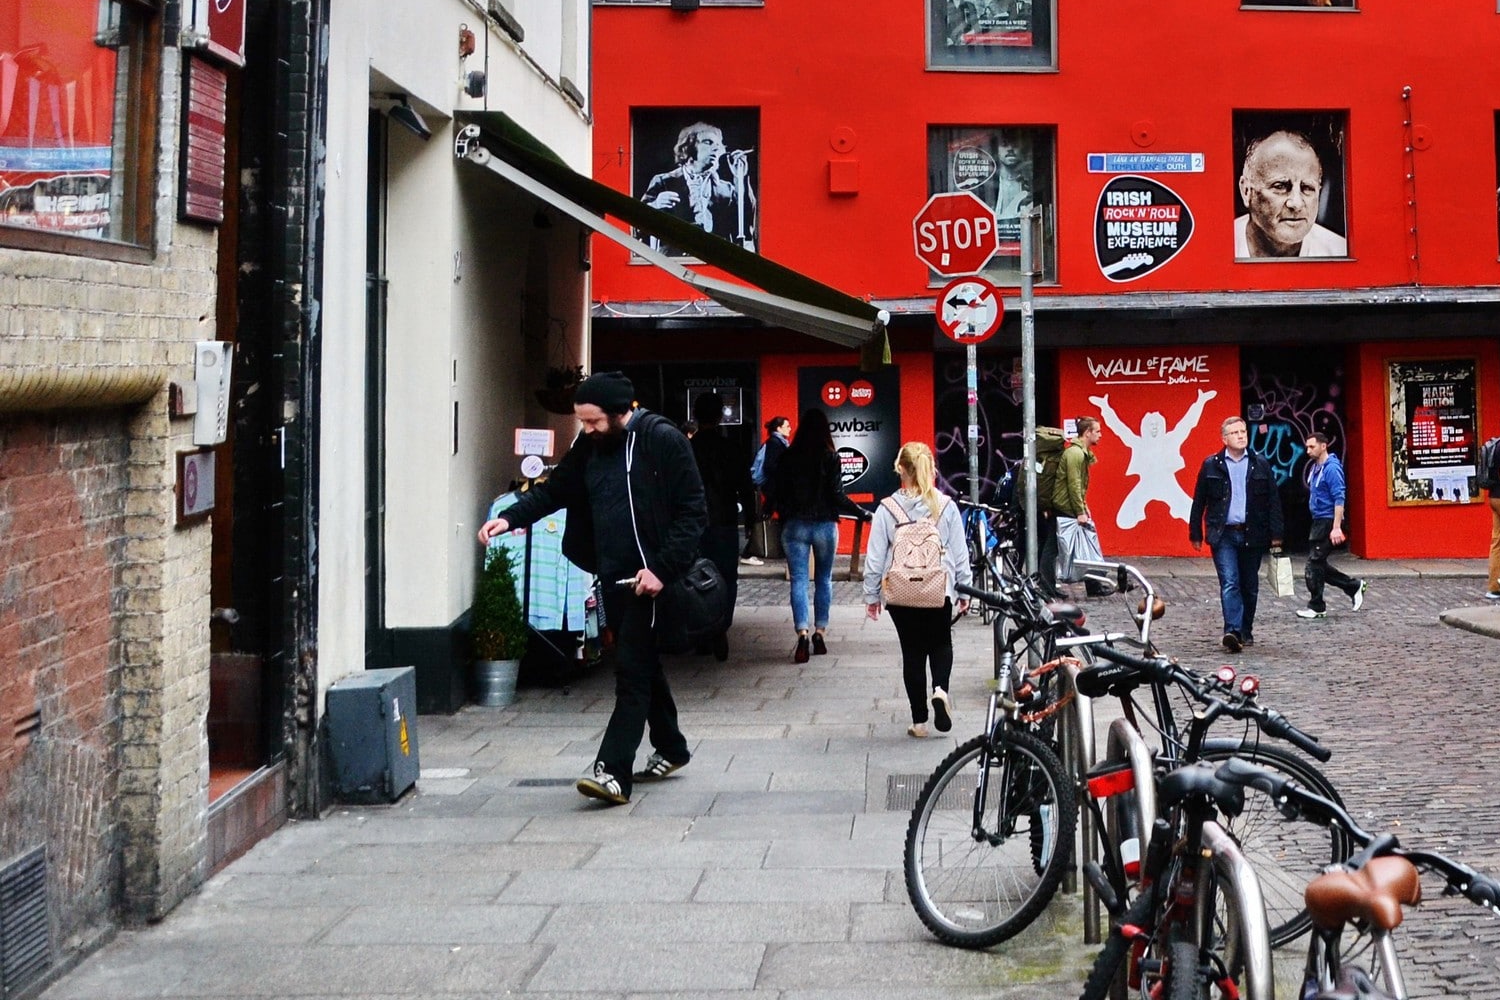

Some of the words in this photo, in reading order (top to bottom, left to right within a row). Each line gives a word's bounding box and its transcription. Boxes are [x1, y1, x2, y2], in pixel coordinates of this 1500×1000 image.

[1162, 163, 1187, 171] SOUTH
[1194, 158, 1202, 168] 2
[1106, 191, 1152, 206] IRISH
[919, 217, 992, 253] STOP
[1106, 221, 1178, 236] MUSEUM
[1107, 236, 1178, 249] EXPERIENCE
[1086, 356, 1148, 378] WALL
[1146, 356, 1159, 369] OF
[1158, 355, 1210, 378] FAME
[1422, 397, 1455, 407] BUTTON
[829, 417, 882, 432] owbar
